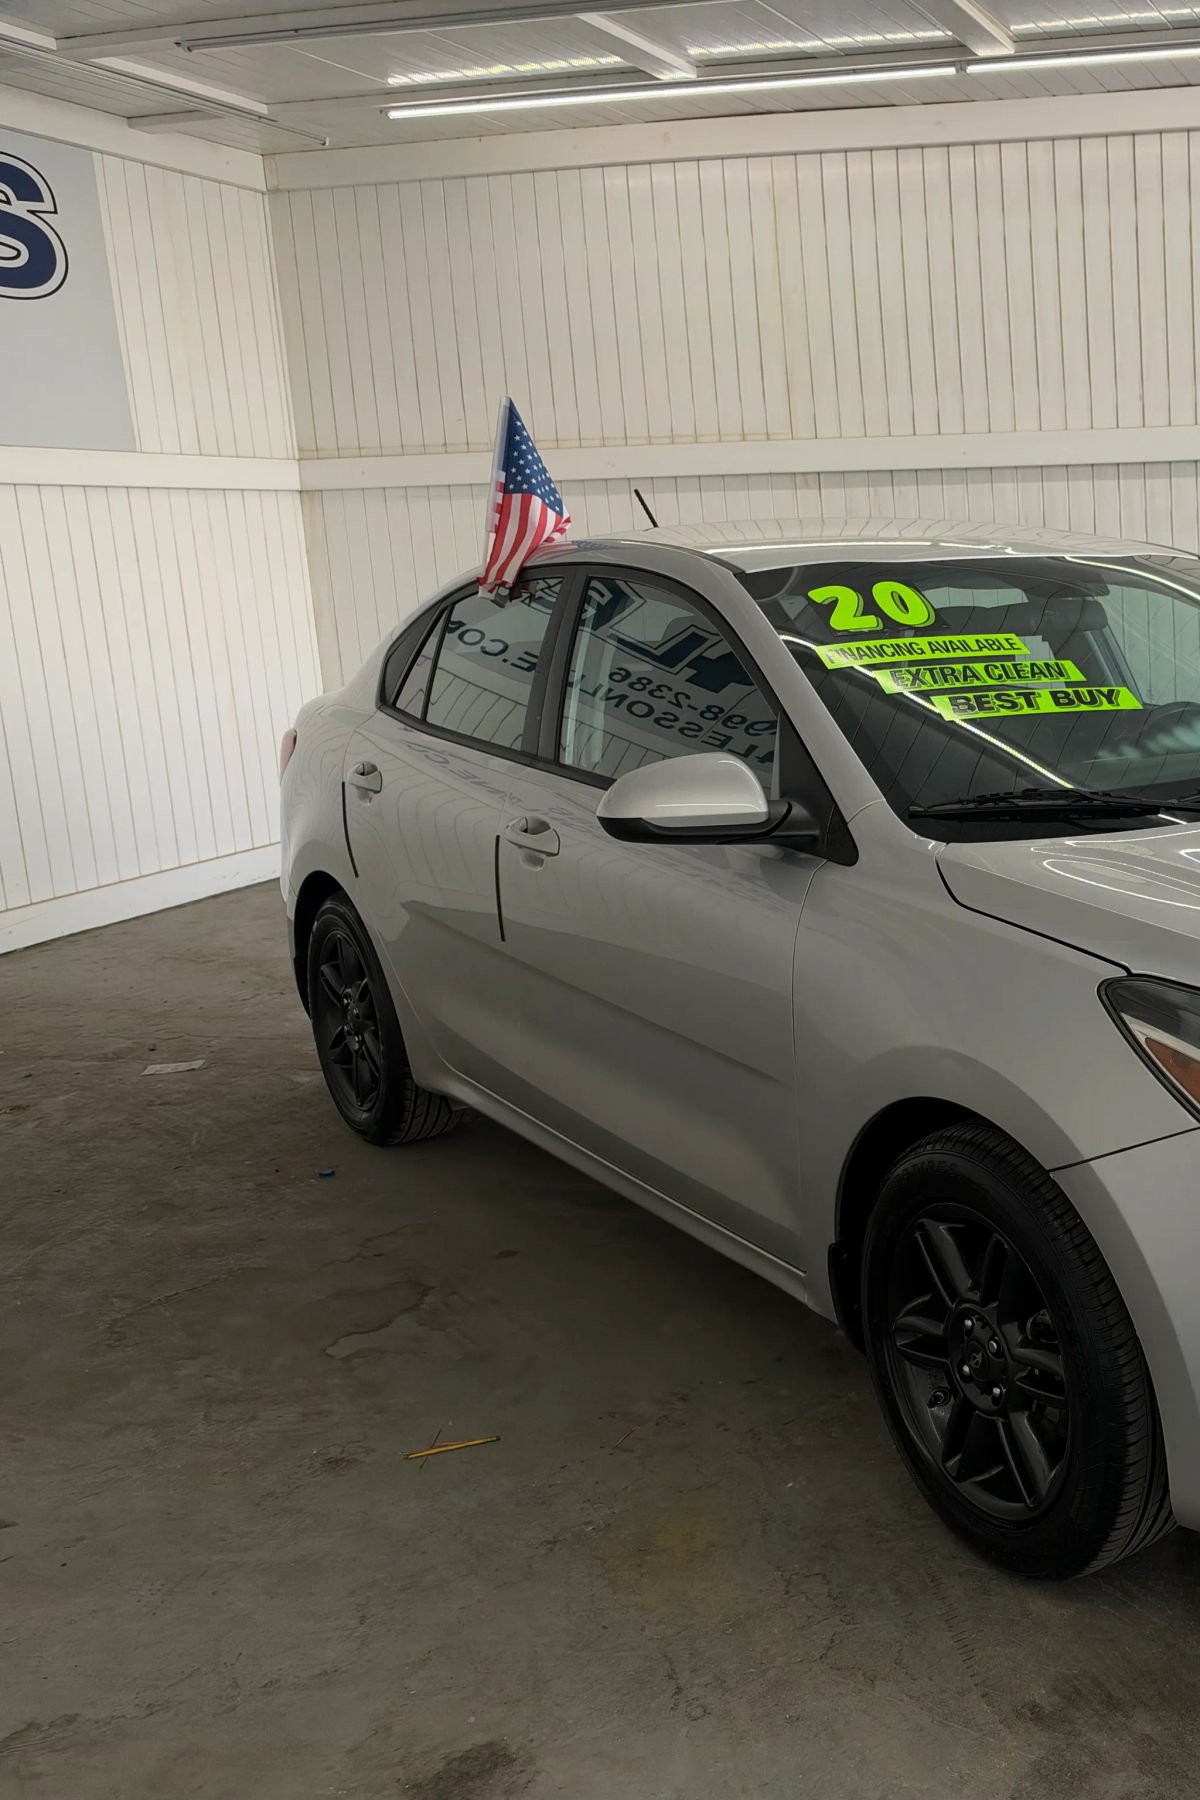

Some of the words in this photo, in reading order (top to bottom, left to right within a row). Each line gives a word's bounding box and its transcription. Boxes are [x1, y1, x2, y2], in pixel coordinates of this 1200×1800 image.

[807, 580, 937, 633] 20
[827, 640, 924, 665] FINANCING
[928, 637, 1022, 654] AVAILABLE
[889, 665, 984, 689] EXTRA
[984, 662, 1071, 682] CLEAN
[948, 691, 1041, 715] BEST
[1049, 688, 1121, 709] BUY
